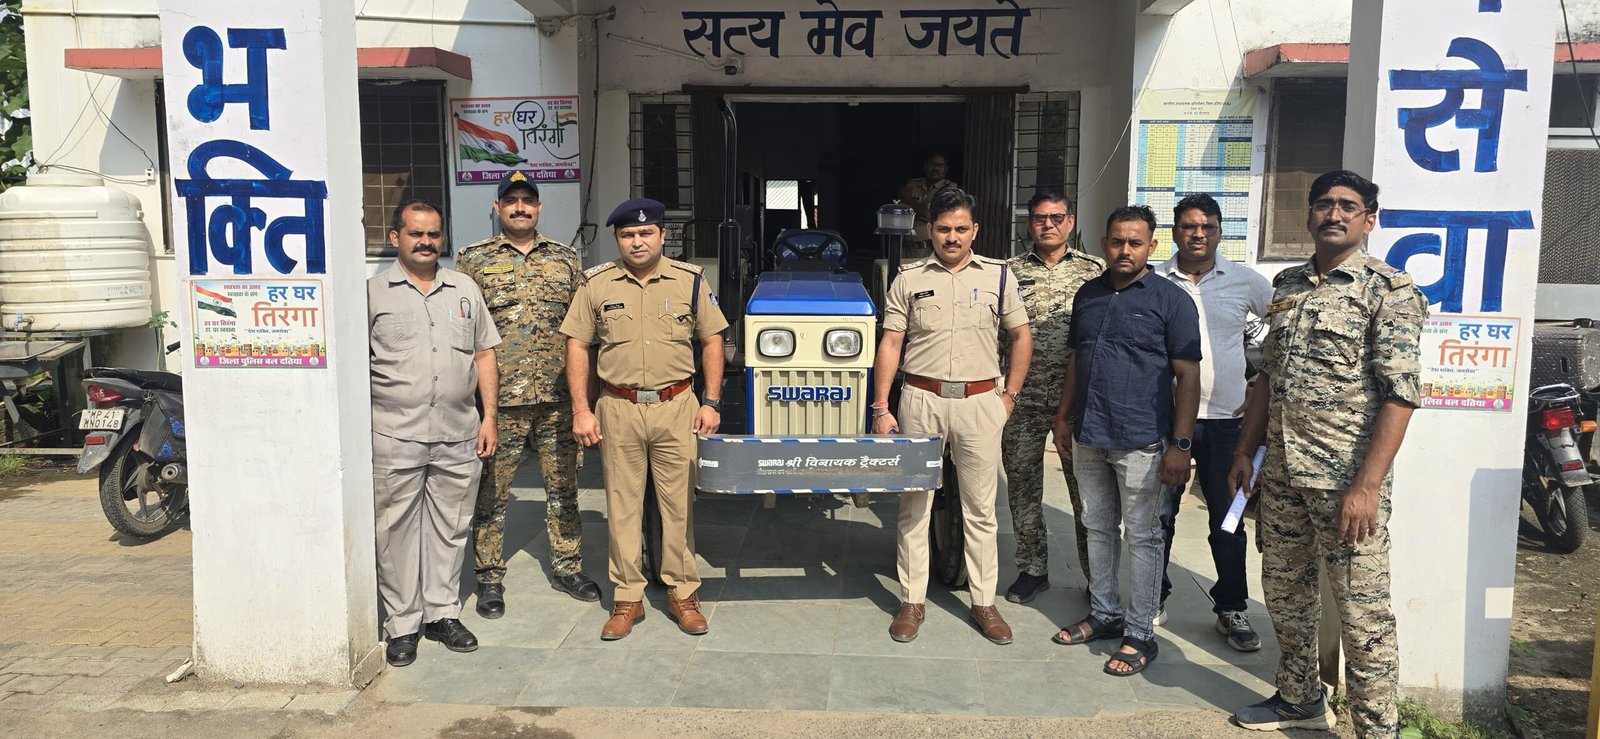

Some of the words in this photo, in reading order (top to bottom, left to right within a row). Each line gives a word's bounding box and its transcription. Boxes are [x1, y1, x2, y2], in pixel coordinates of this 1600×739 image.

[681, 11, 786, 58] सत्य
[799, 0, 884, 58] मेव
[900, 0, 1031, 59] जयते
[493, 111, 512, 127] हर
[516, 110, 538, 124] घर
[519, 124, 565, 150] तिरंगा
[482, 171, 500, 180] जिला
[537, 170, 557, 179] दतिया
[267, 286, 288, 302] हर
[292, 286, 316, 301] घर
[251, 301, 318, 327] तिरंगा
[1459, 323, 1482, 341] हर
[1487, 324, 1514, 340] घर
[1438, 339, 1512, 368] तिरंगा
[218, 357, 239, 365] जिला
[241, 357, 263, 367] पुलिस
[280, 357, 302, 365] दतिया
[1445, 398, 1461, 407] बल
[1463, 398, 1486, 408] दतिया
[90, 410, 102, 419] MP
[104, 411, 115, 419] 41
[83, 419, 119, 428] MN0148
[785, 456, 802, 467] श्री
[804, 455, 857, 467] विनायक
[859, 454, 902, 469] ट्रैक्टर्स
